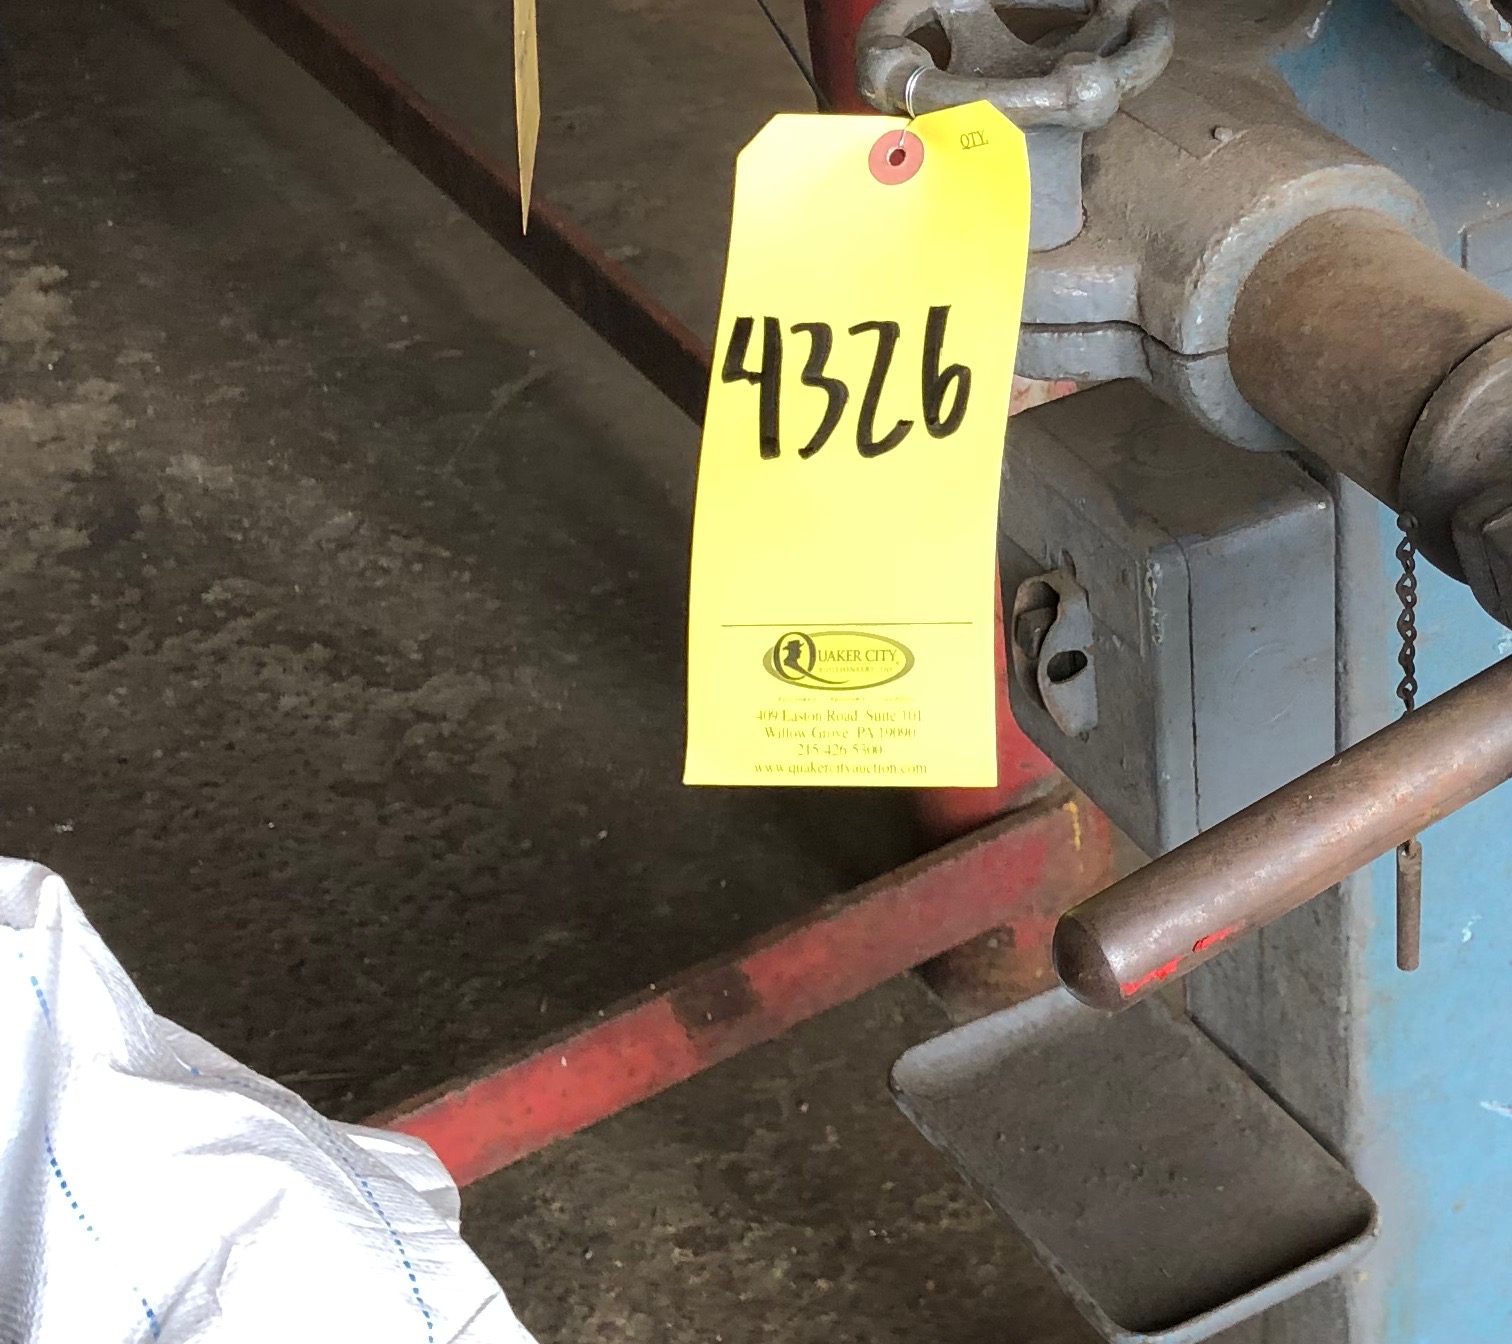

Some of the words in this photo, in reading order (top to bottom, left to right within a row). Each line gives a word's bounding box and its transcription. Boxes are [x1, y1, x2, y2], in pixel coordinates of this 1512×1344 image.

[721, 304, 972, 460] 4326
[773, 631, 863, 684] QUAKER
[865, 648, 898, 663] CITY
[756, 710, 778, 722] 409
[782, 709, 823, 722] Easton
[865, 709, 896, 722] Suite
[764, 726, 806, 739] Willow
[857, 726, 874, 739] PA
